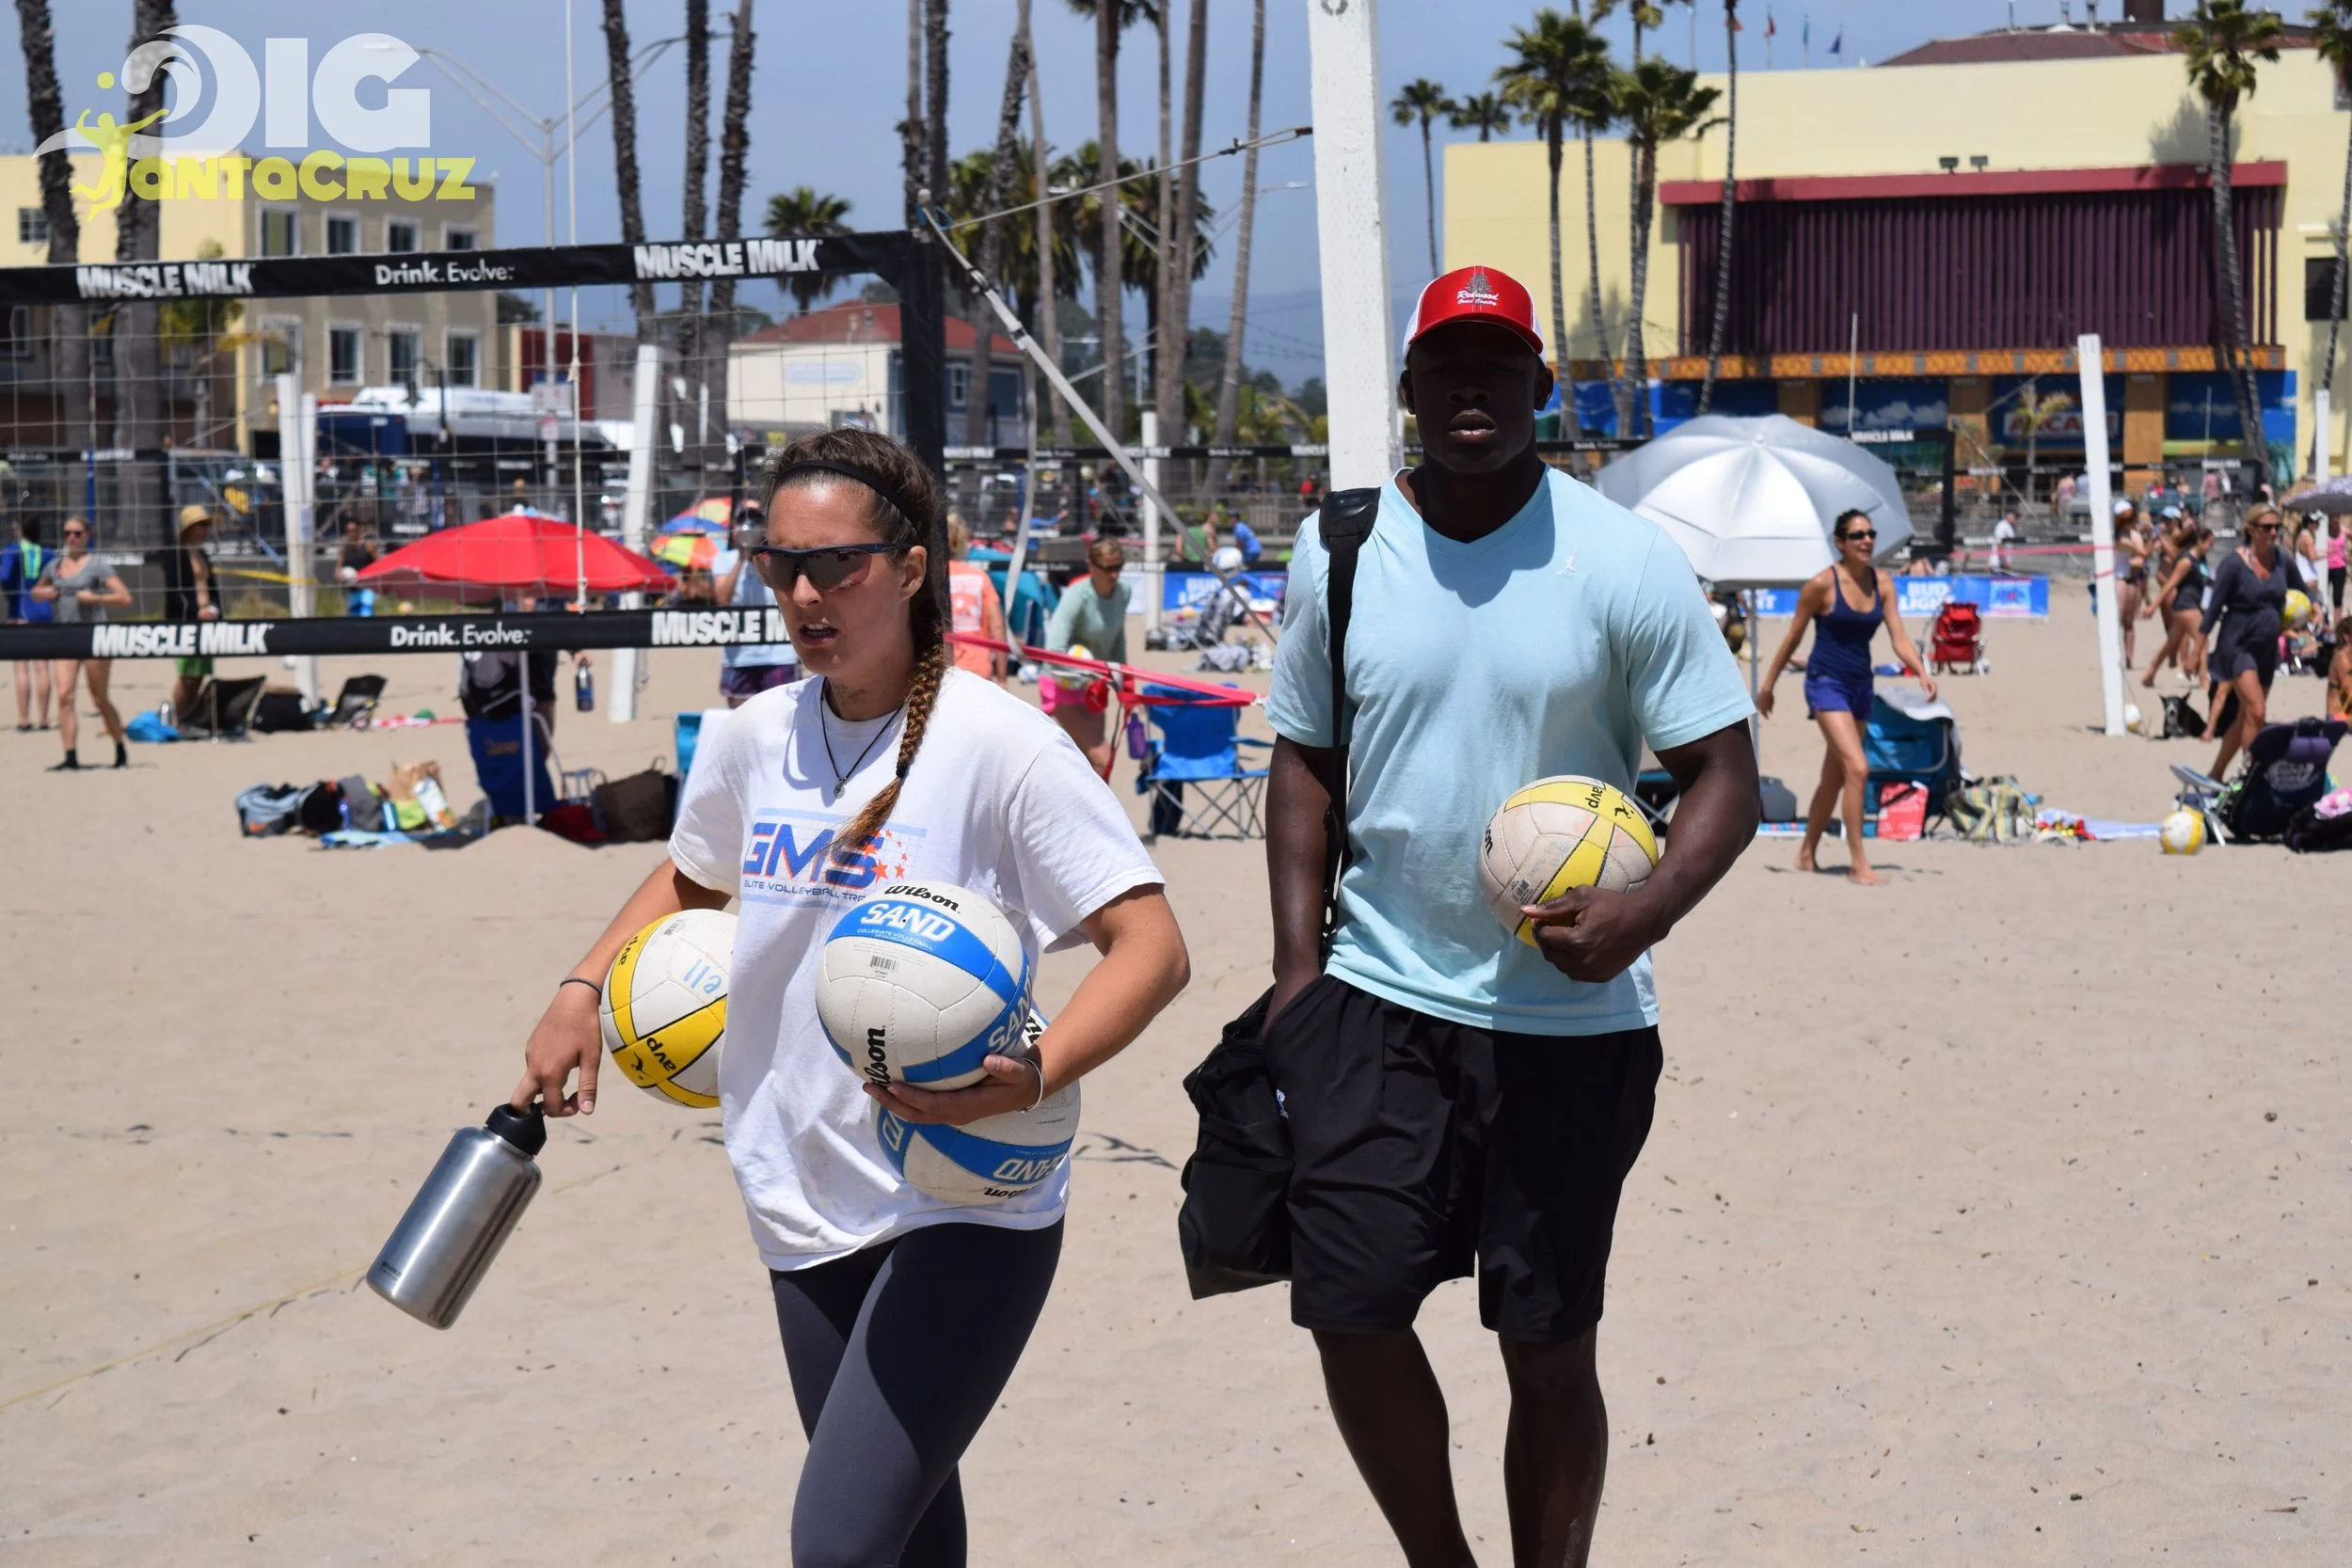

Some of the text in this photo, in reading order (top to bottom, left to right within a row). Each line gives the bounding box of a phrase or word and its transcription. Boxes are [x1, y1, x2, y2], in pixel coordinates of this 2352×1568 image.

[634, 239, 820, 279] MUSCLE MILK
[76, 265, 183, 298] MUSCLE
[183, 262, 255, 294] MILK
[374, 262, 446, 285] Drink.
[92, 625, 198, 657] MUSCLE
[199, 622, 268, 655] MILK
[389, 622, 461, 647] Drink.
[651, 610, 761, 645] MUSCLE
[768, 882, 839, 899] VOLLEYBALL
[884, 885, 960, 913] Wilson
[860, 903, 956, 942] SAND
